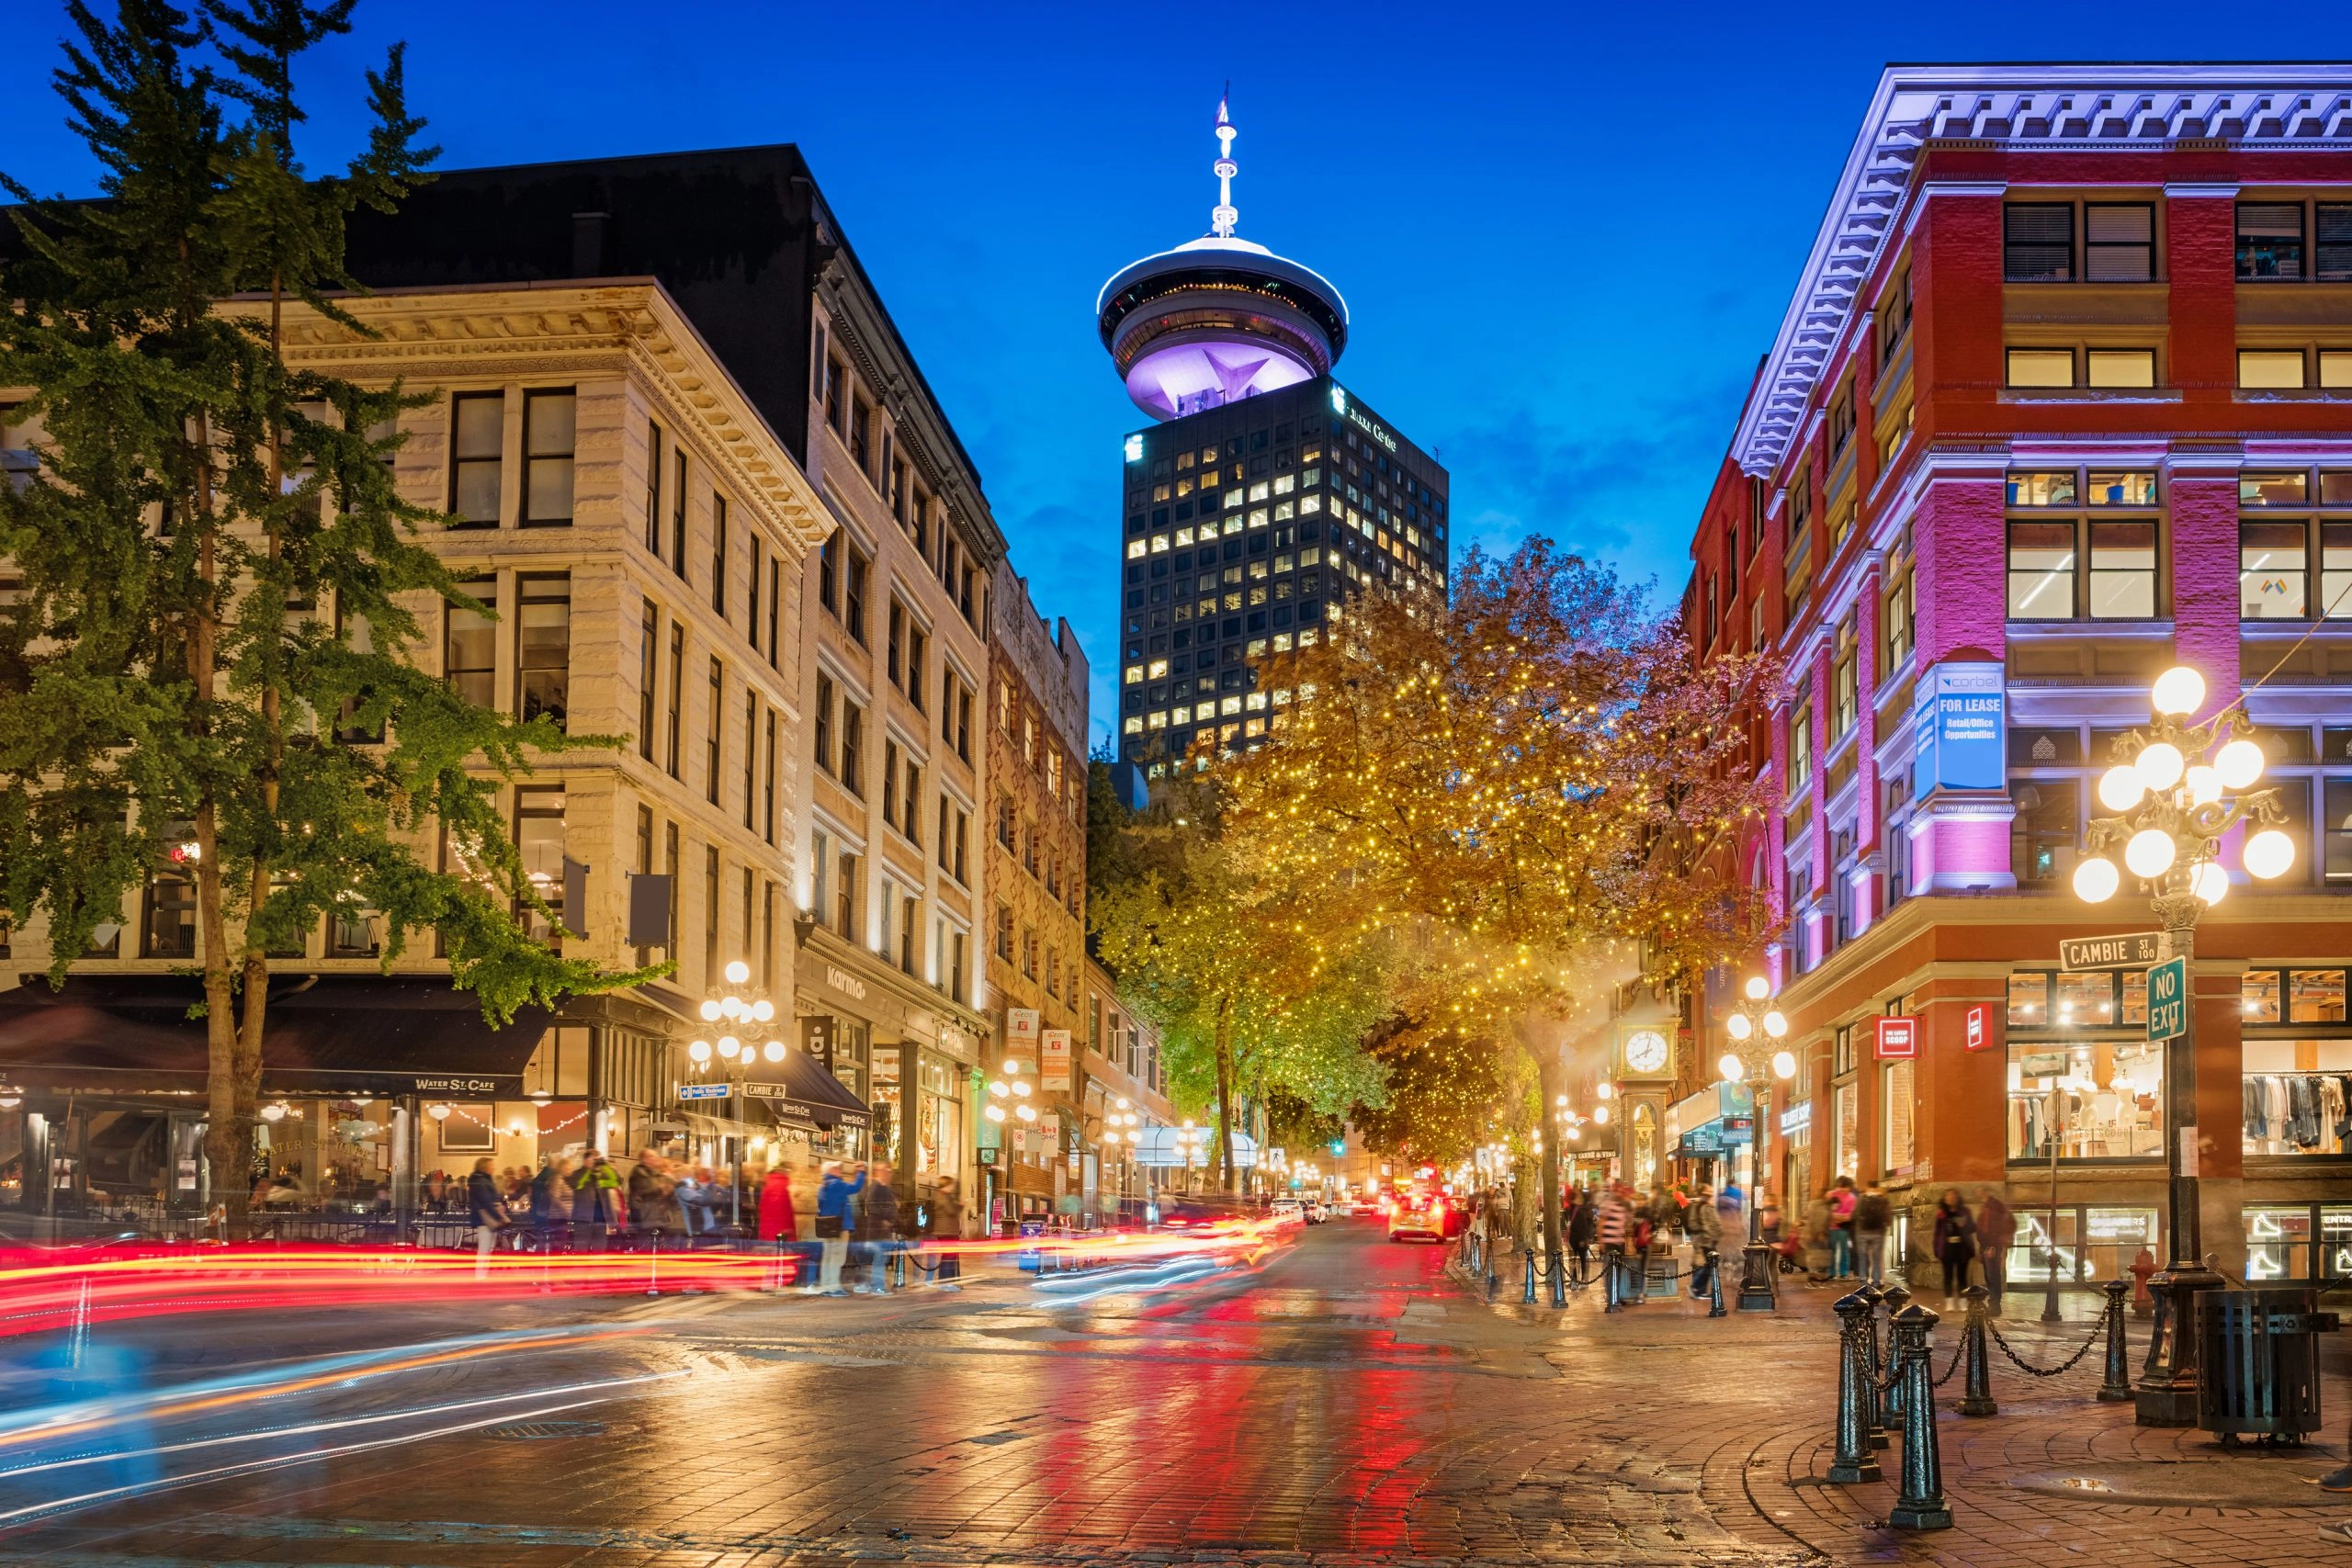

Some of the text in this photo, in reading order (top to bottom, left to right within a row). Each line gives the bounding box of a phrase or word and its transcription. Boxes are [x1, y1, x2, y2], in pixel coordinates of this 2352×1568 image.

[1951, 675, 1998, 688] corbel
[1939, 698, 2001, 713] FOR LEASE
[1946, 718, 1994, 728] Retail/Office
[1944, 729, 1996, 740] Opportunities
[2139, 939, 2149, 950] ST
[2070, 941, 2128, 964] CAMBIE
[2138, 949, 2154, 960] 100
[2155, 971, 2176, 1000] NO
[2151, 1000, 2181, 1032] EXIT
[1885, 1036, 1908, 1044] SCOOP
[415, 1078, 448, 1089] WATER
[468, 1079, 494, 1090] CAFE
[749, 1085, 773, 1096] CAMBIE
[258, 1139, 303, 1158] WATER
